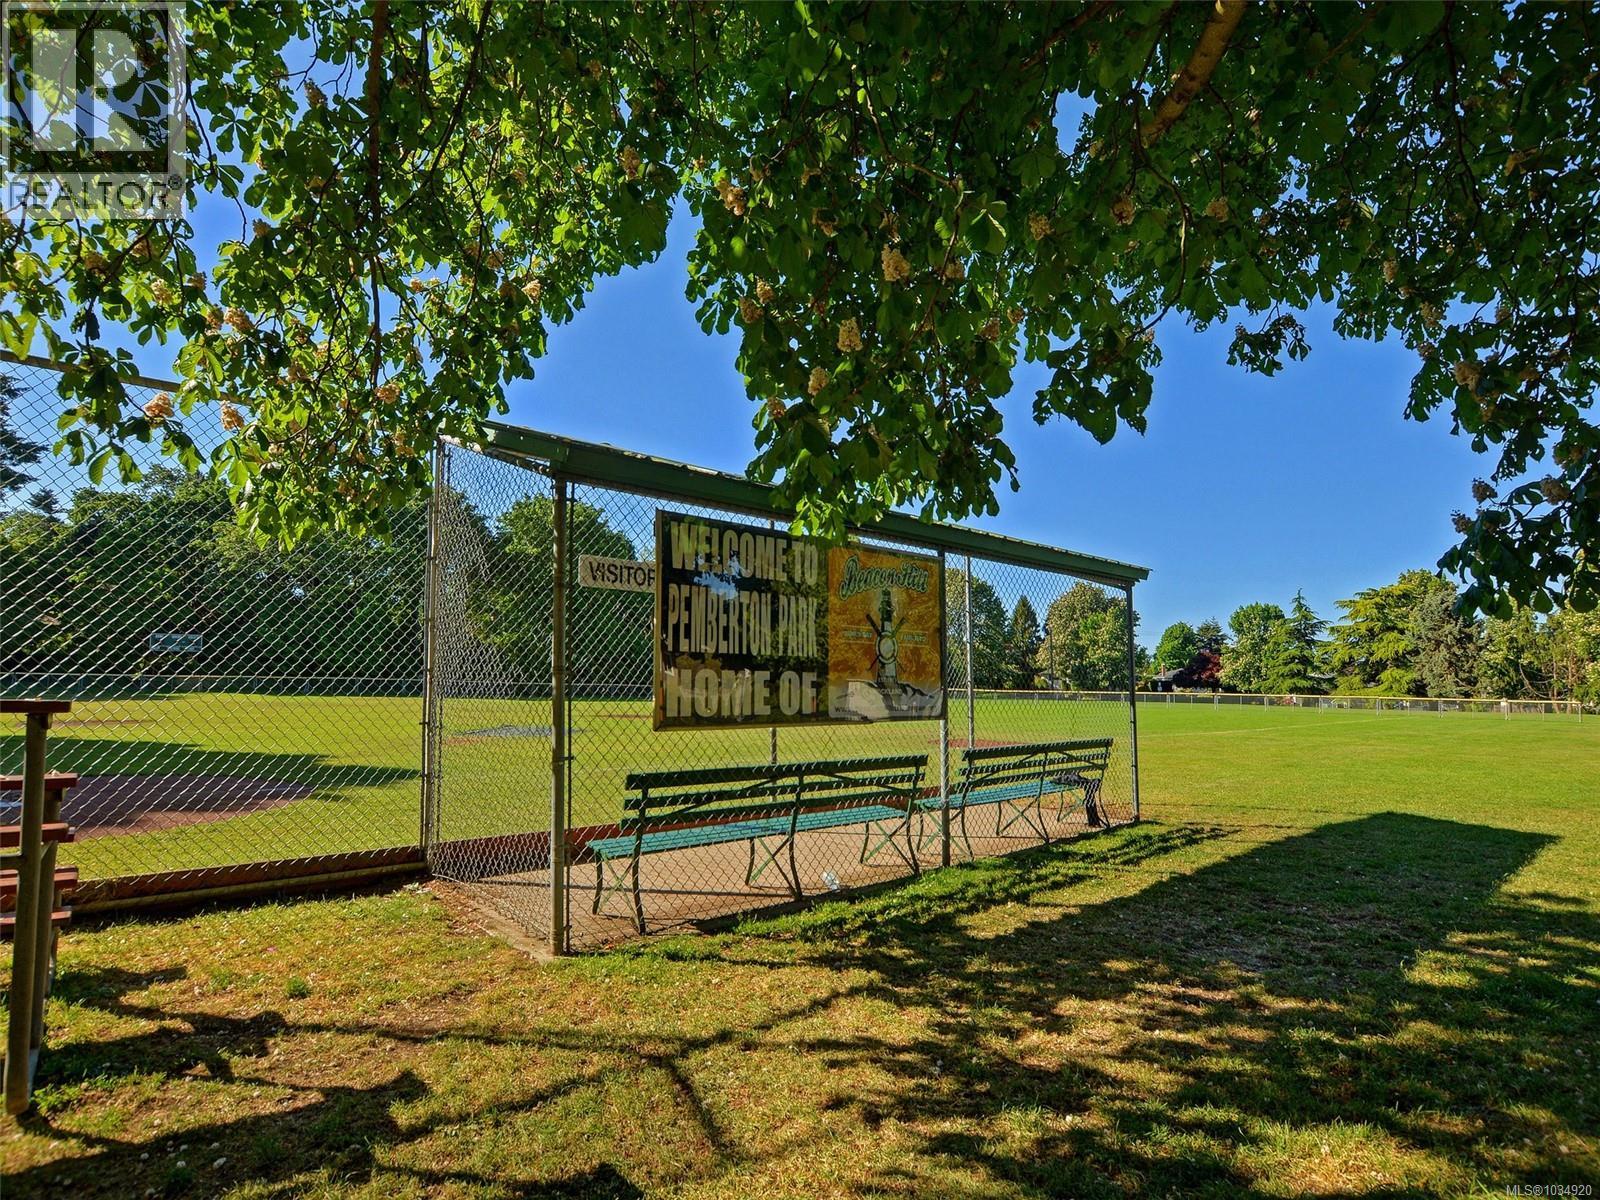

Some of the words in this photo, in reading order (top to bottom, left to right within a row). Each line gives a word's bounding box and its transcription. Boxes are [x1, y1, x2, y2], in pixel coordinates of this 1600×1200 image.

[670, 521, 787, 581] WELCOME
[792, 541, 819, 585] TO
[668, 583, 772, 655] PEMBERTON
[778, 594, 817, 657] PARK
[666, 668, 771, 717] HOME
[779, 670, 817, 716] OF
